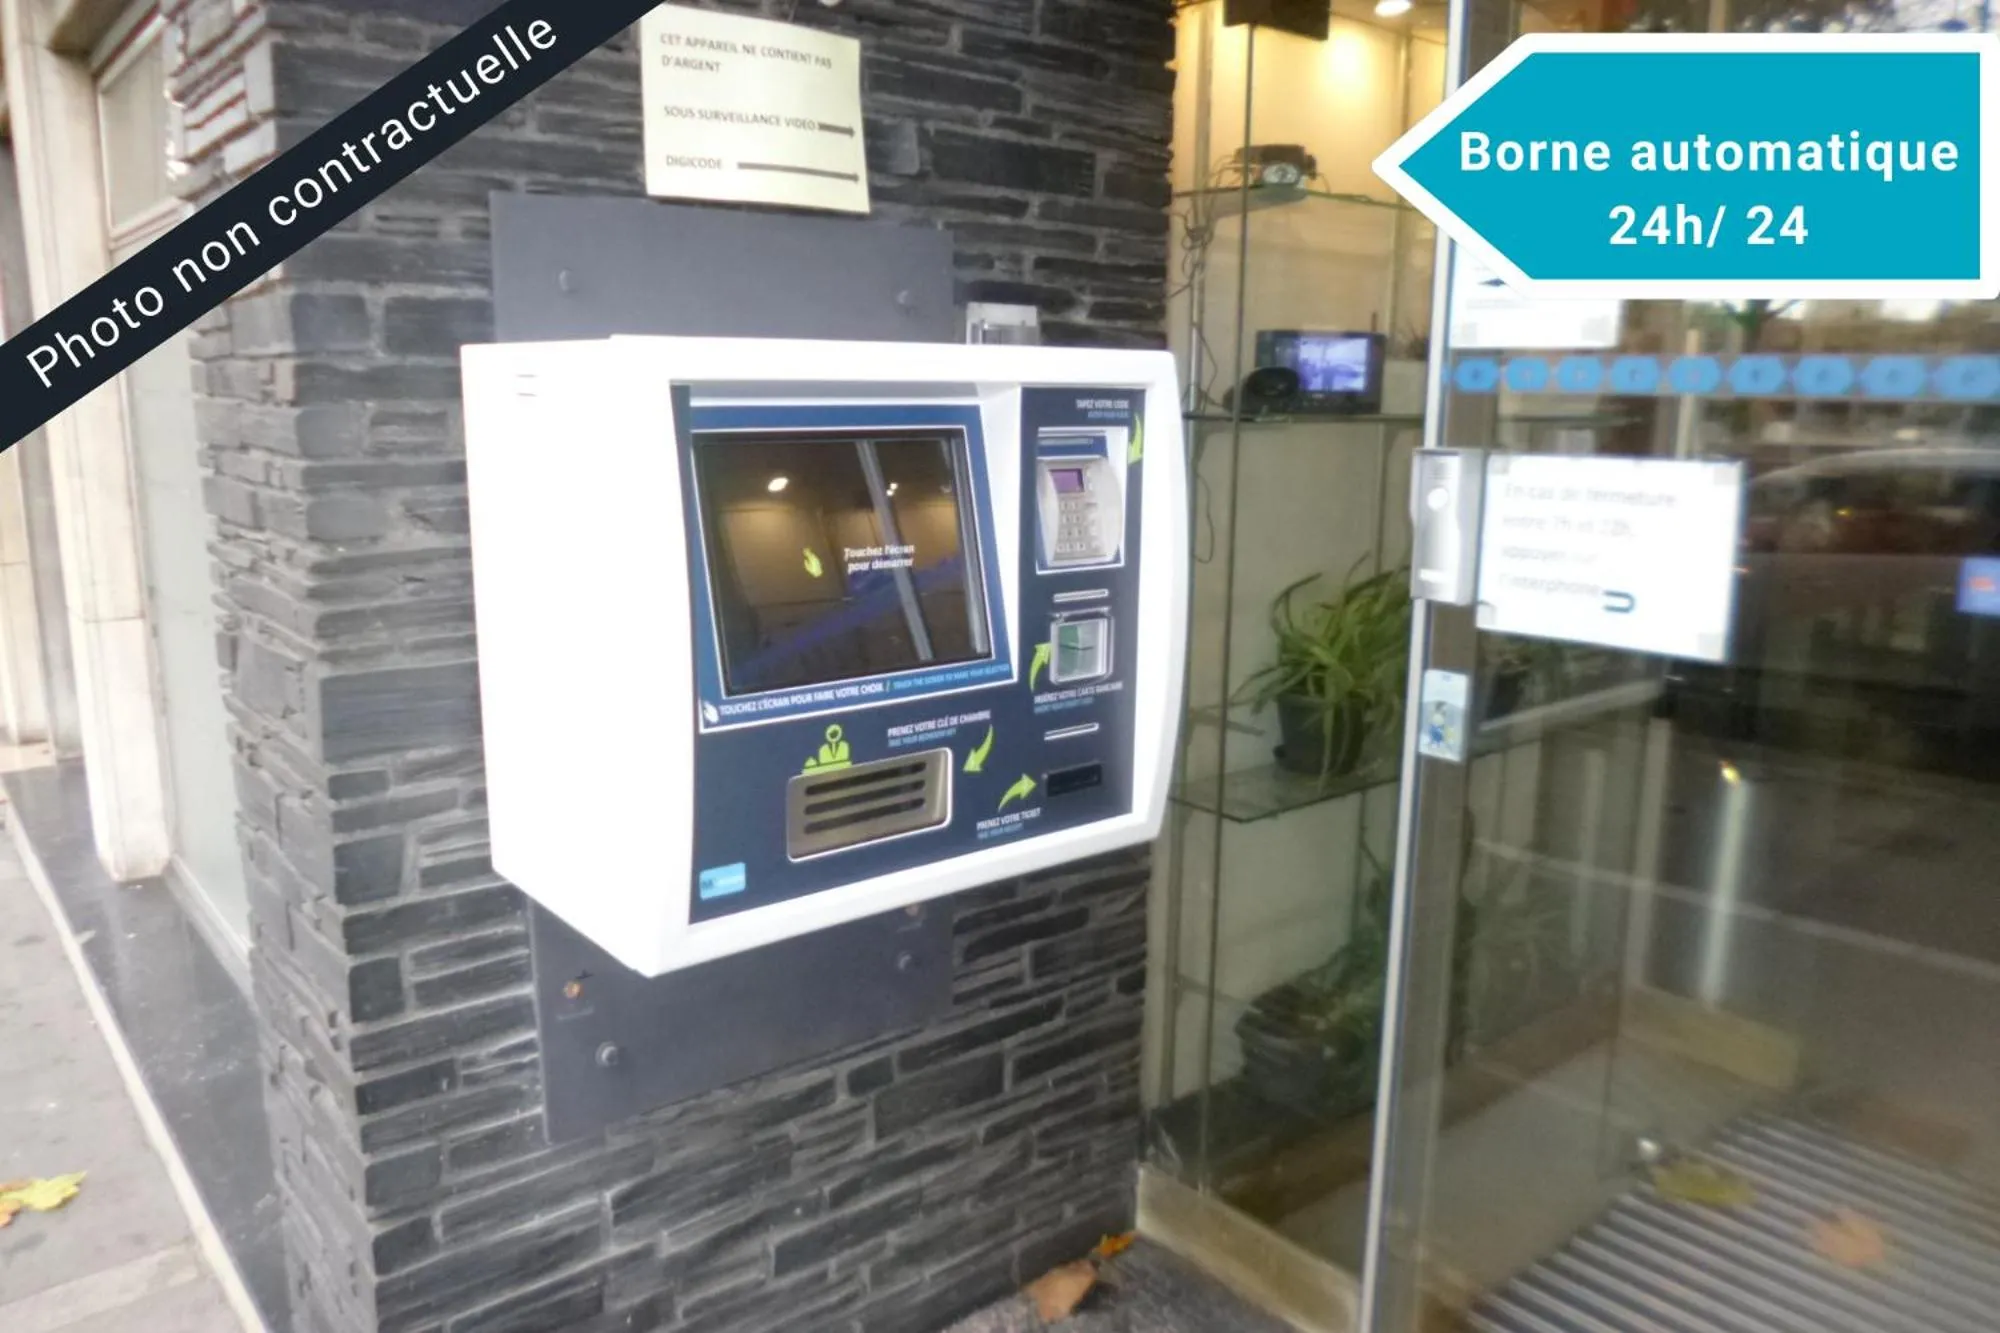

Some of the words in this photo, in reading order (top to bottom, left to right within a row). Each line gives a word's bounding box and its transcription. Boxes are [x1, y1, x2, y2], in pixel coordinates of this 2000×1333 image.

[659, 32, 681, 46] CET
[684, 36, 738, 54] APPAREIL
[742, 43, 757, 57] NE
[761, 45, 812, 65] CONTIENT
[814, 55, 832, 70] PAS
[662, 54, 721, 73] D'ARGENT
[663, 106, 695, 119] SOUS
[697, 108, 782, 127] SURVEILLANCE
[784, 117, 816, 131] VIDEO
[665, 154, 723, 170] DIGICODE
[843, 546, 883, 562] Touchez
[847, 561, 870, 575] pour
[719, 703, 757, 716] TOUCHEZ
[790, 694, 813, 705] POUR
[814, 690, 835, 702] FAIRE
[835, 687, 859, 698] VOTRE
[860, 683, 884, 694] CHOIX
[887, 724, 914, 738] PRENEZ
[914, 719, 936, 732] VOTRE
